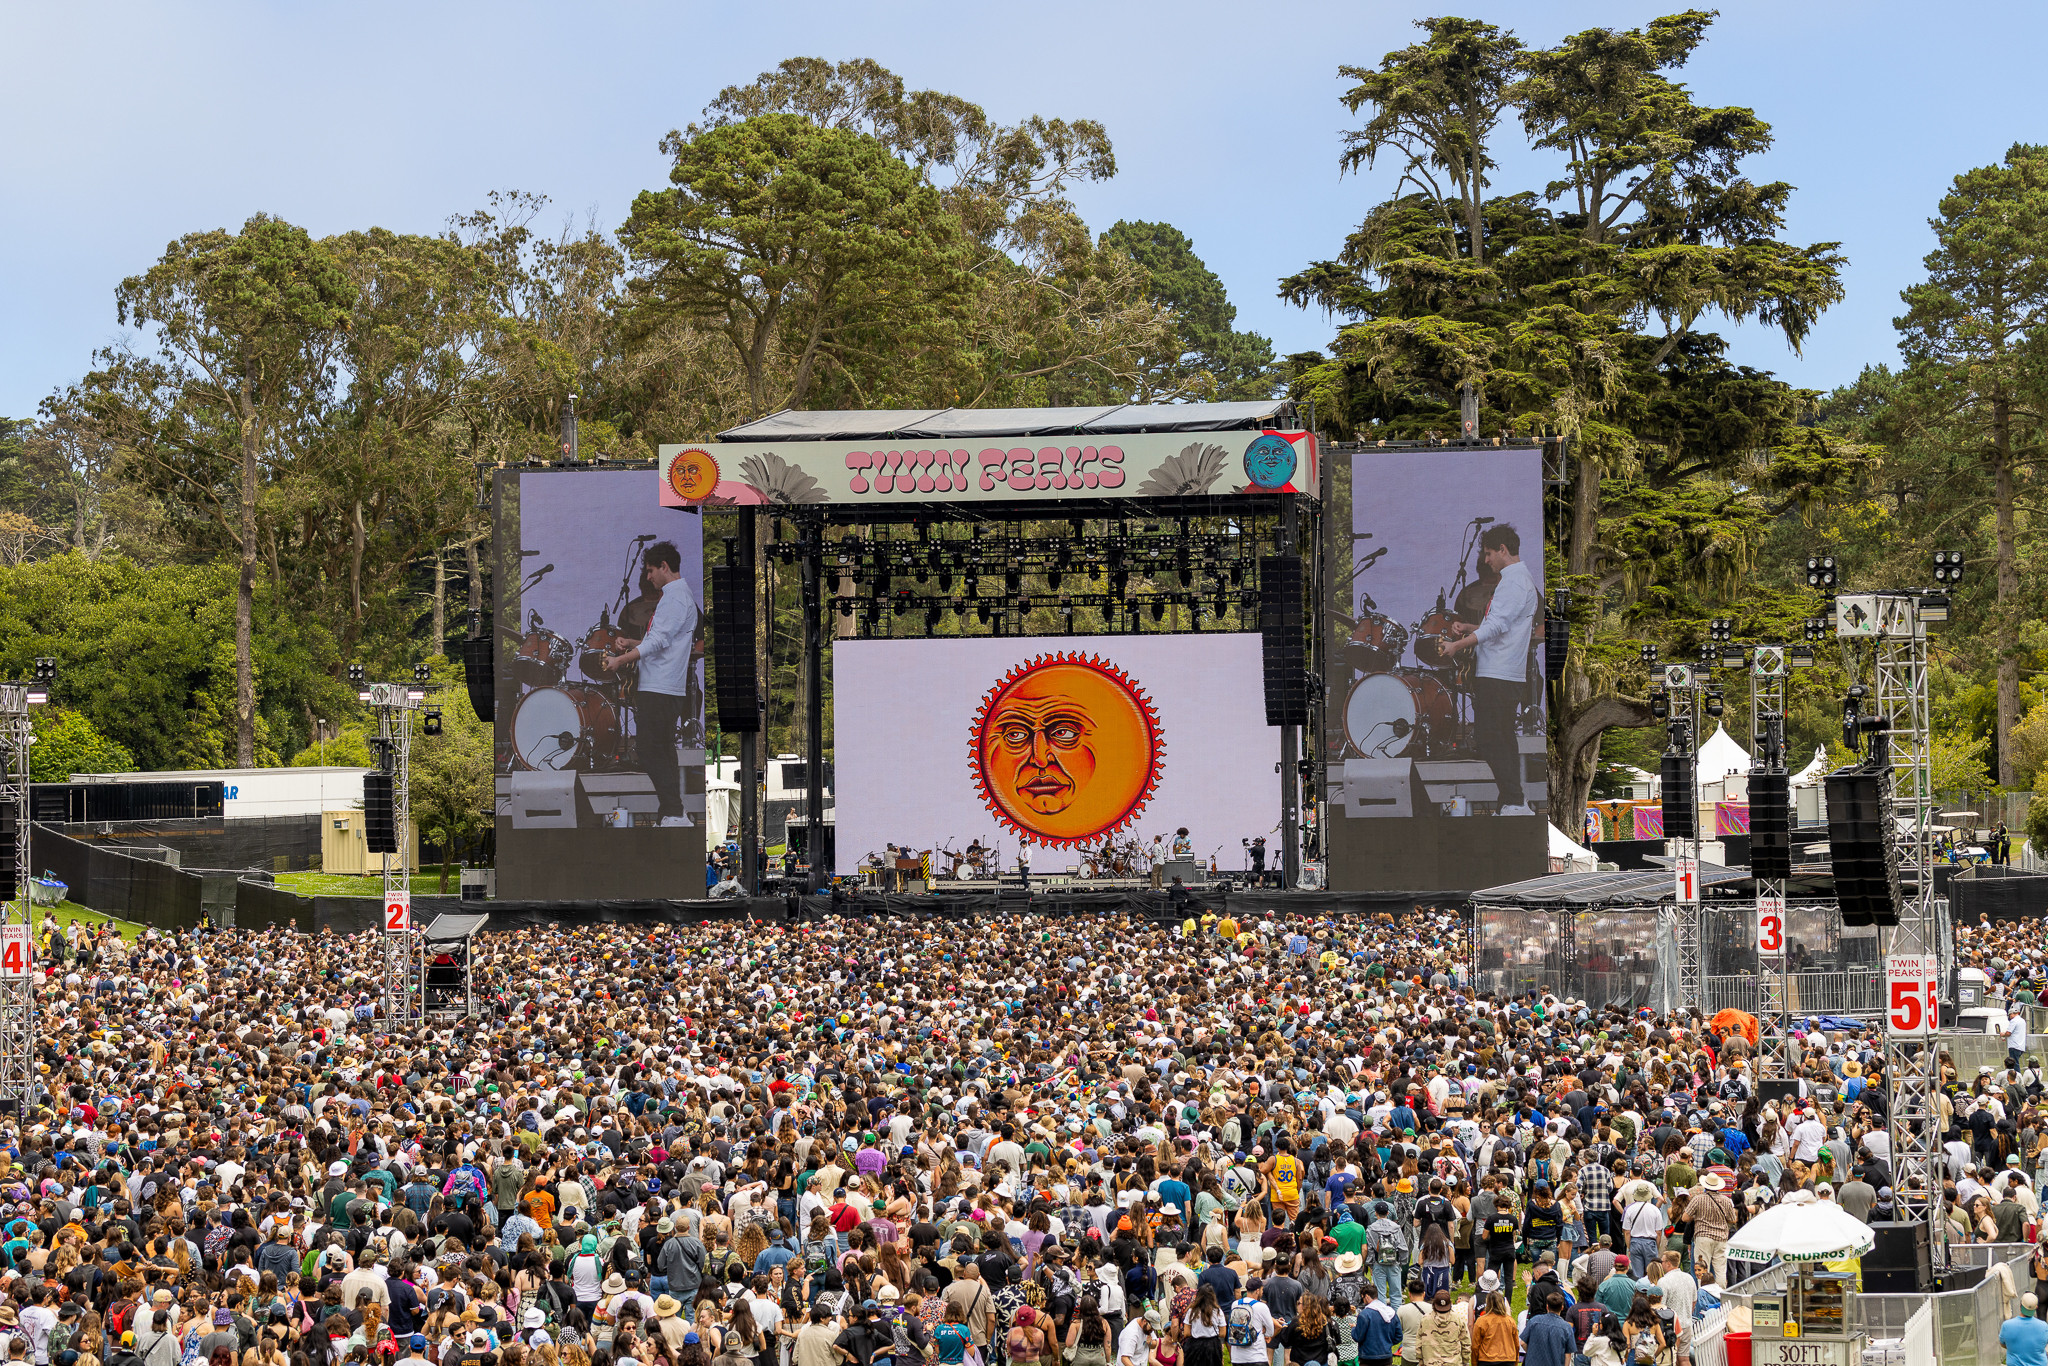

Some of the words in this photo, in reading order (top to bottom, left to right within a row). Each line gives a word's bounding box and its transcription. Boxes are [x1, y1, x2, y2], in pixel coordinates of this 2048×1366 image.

[845, 449, 970, 494] TWIN
[978, 445, 1126, 491] PEAKS
[1679, 873, 1692, 900] 1
[387, 903, 404, 929] 2
[1760, 916, 1783, 951] 3
[1, 941, 24, 974] 4
[1891, 959, 1919, 968] TWIN
[1888, 969, 1922, 977] PEAKS
[1891, 982, 1922, 1031] 5
[1927, 981, 1938, 1030] 5
[1278, 1170, 1294, 1183] 30
[1493, 1225, 1514, 1233] VOTE?
[1728, 1248, 1772, 1261] PRETZELS
[1782, 1249, 1845, 1262] CHURROS
[1779, 1345, 1821, 1363] SOFT
